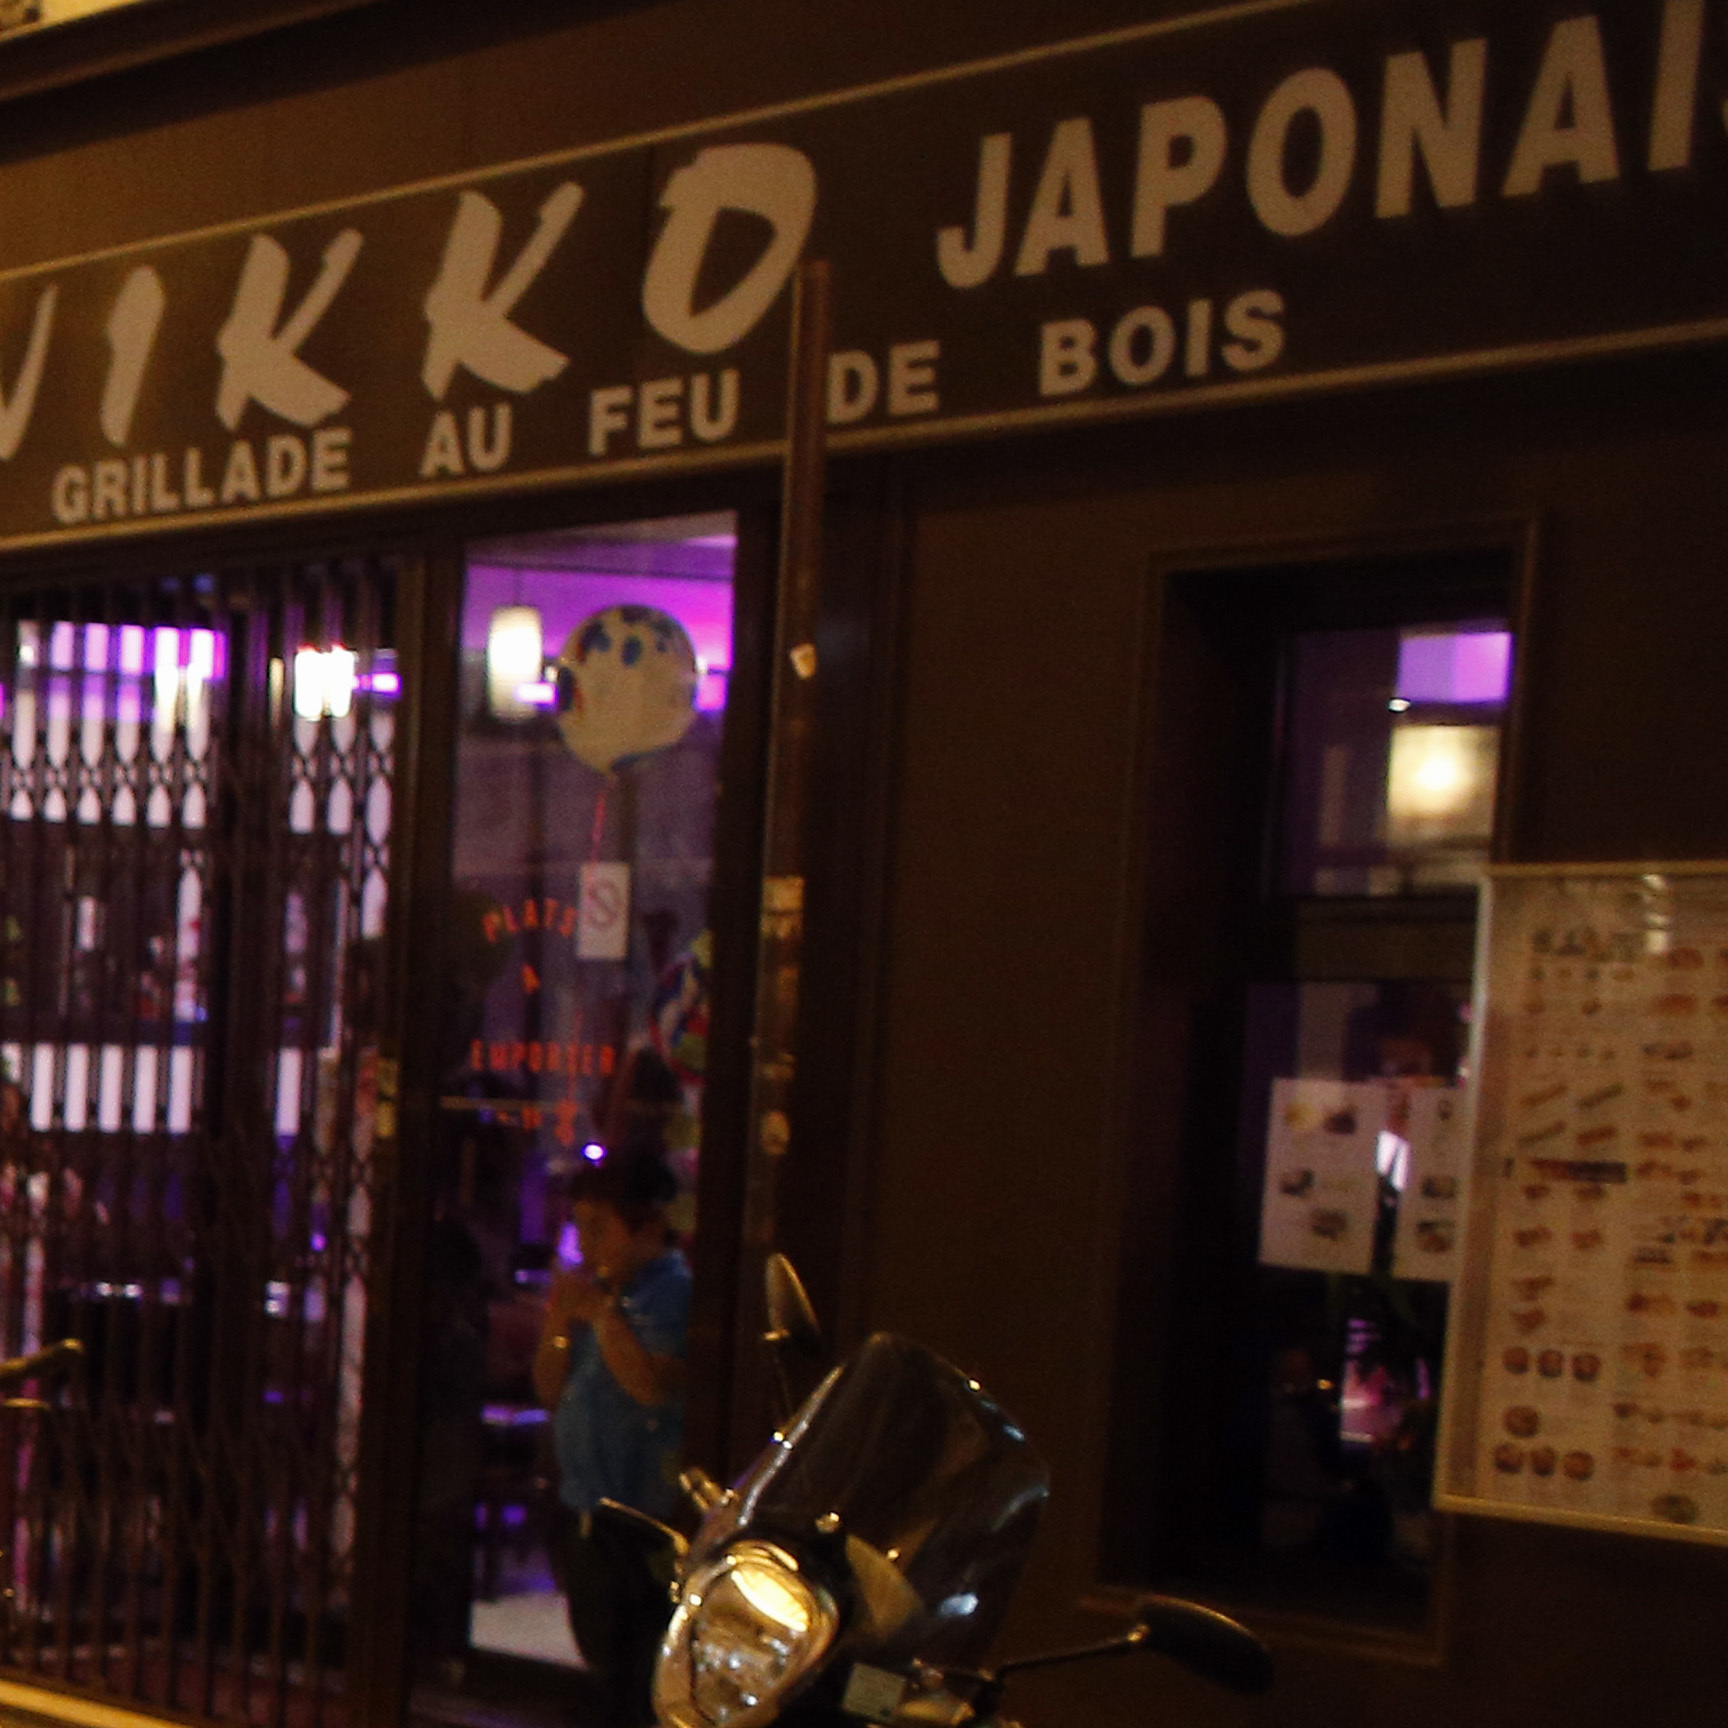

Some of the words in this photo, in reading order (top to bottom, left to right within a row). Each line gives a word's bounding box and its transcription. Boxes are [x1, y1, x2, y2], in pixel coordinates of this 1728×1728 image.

[936, 0, 1728, 289] JAPONAI
[51, 428, 352, 524] GRILLADE
[420, 403, 513, 478] AU
[587, 369, 740, 455] FEU
[826, 340, 940, 425] DE
[1038, 290, 1286, 397] BOIS
